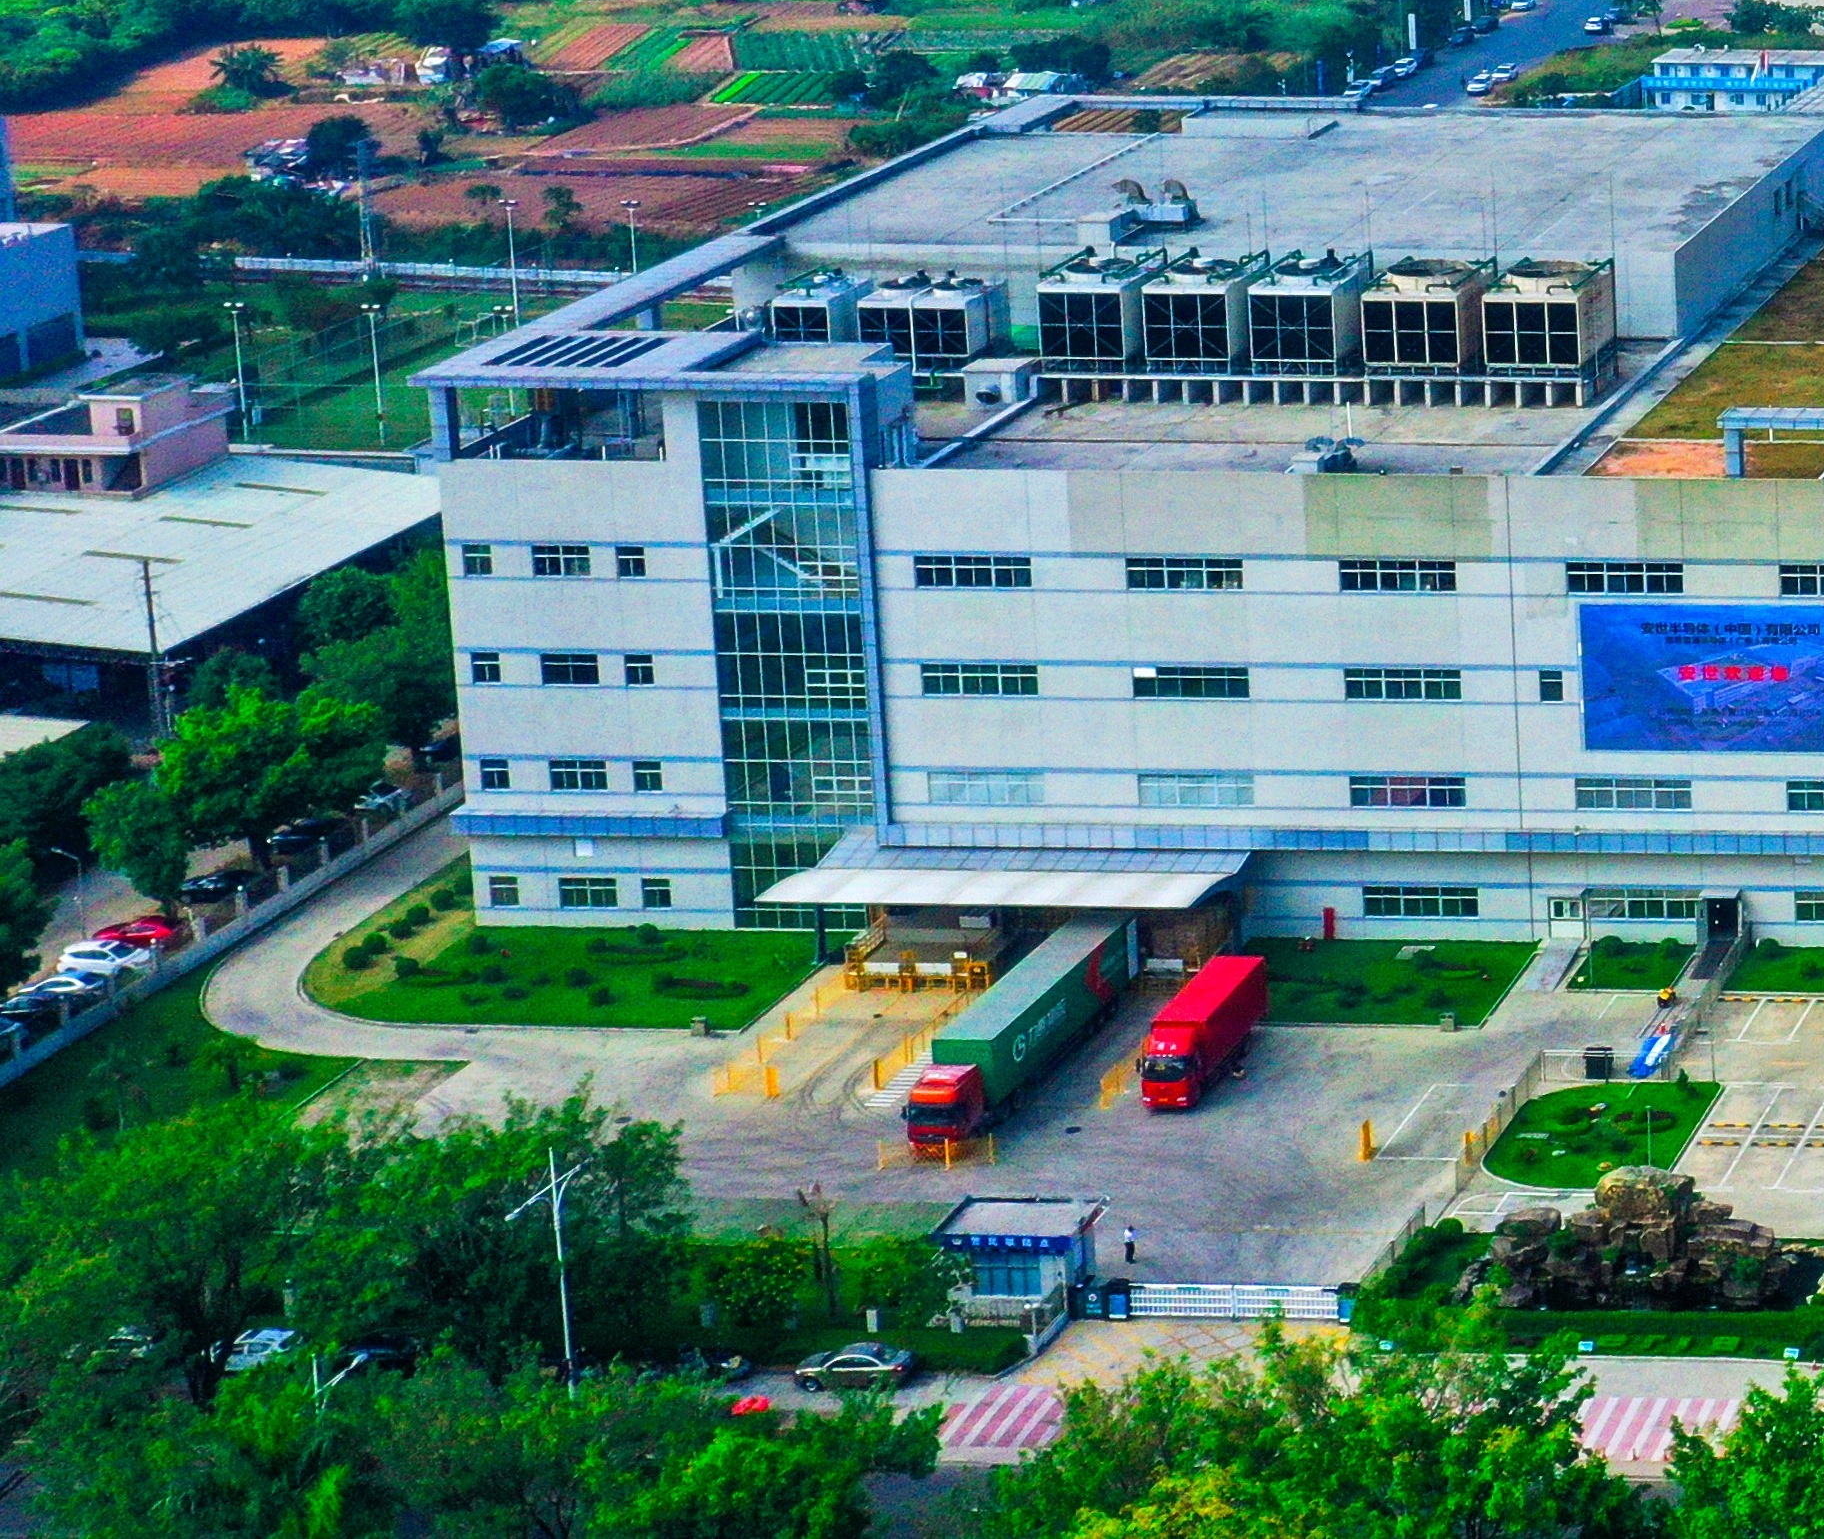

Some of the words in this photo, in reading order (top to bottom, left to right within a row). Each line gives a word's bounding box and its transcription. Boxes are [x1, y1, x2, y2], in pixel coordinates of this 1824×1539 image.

[1641, 623, 1821, 636] 安世半导体（中国）有限公司
